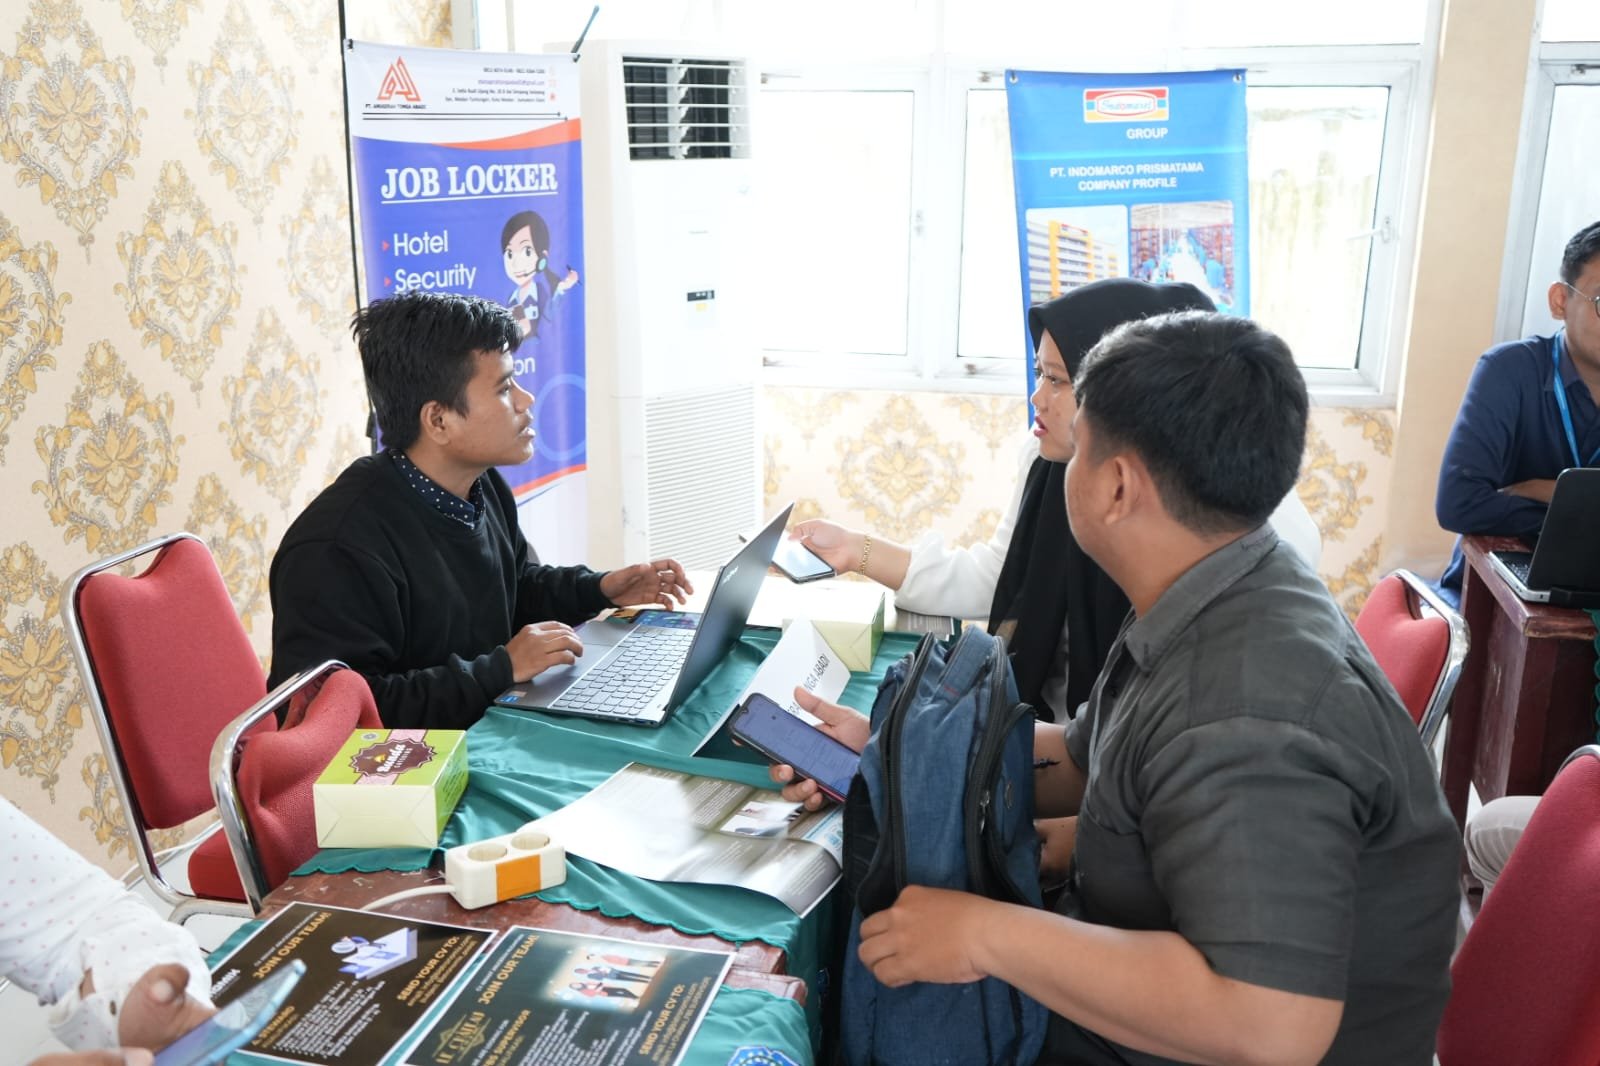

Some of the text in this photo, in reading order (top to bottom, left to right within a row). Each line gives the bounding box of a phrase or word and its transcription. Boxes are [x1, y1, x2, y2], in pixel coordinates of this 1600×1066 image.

[1126, 128, 1169, 139] GROUP
[381, 163, 558, 199] JOB LOCKER
[1050, 161, 1204, 177] PT. INDOMARCO PRISMATAMA
[1078, 177, 1177, 191] COMPANY PROFILE
[394, 230, 448, 257] Hotel
[395, 264, 476, 292] Security
[513, 356, 536, 376] on
[377, 742, 407, 774] Bunda
[252, 912, 331, 979] JOIN OUR TEAM!
[397, 937, 459, 1000] SEND YOUR CV TO:
[478, 934, 540, 1004] JOIN OUR TEAM!
[494, 1010, 530, 1053] SUPERVISOR
[640, 984, 684, 1054] SEND YOUR CV TO:
